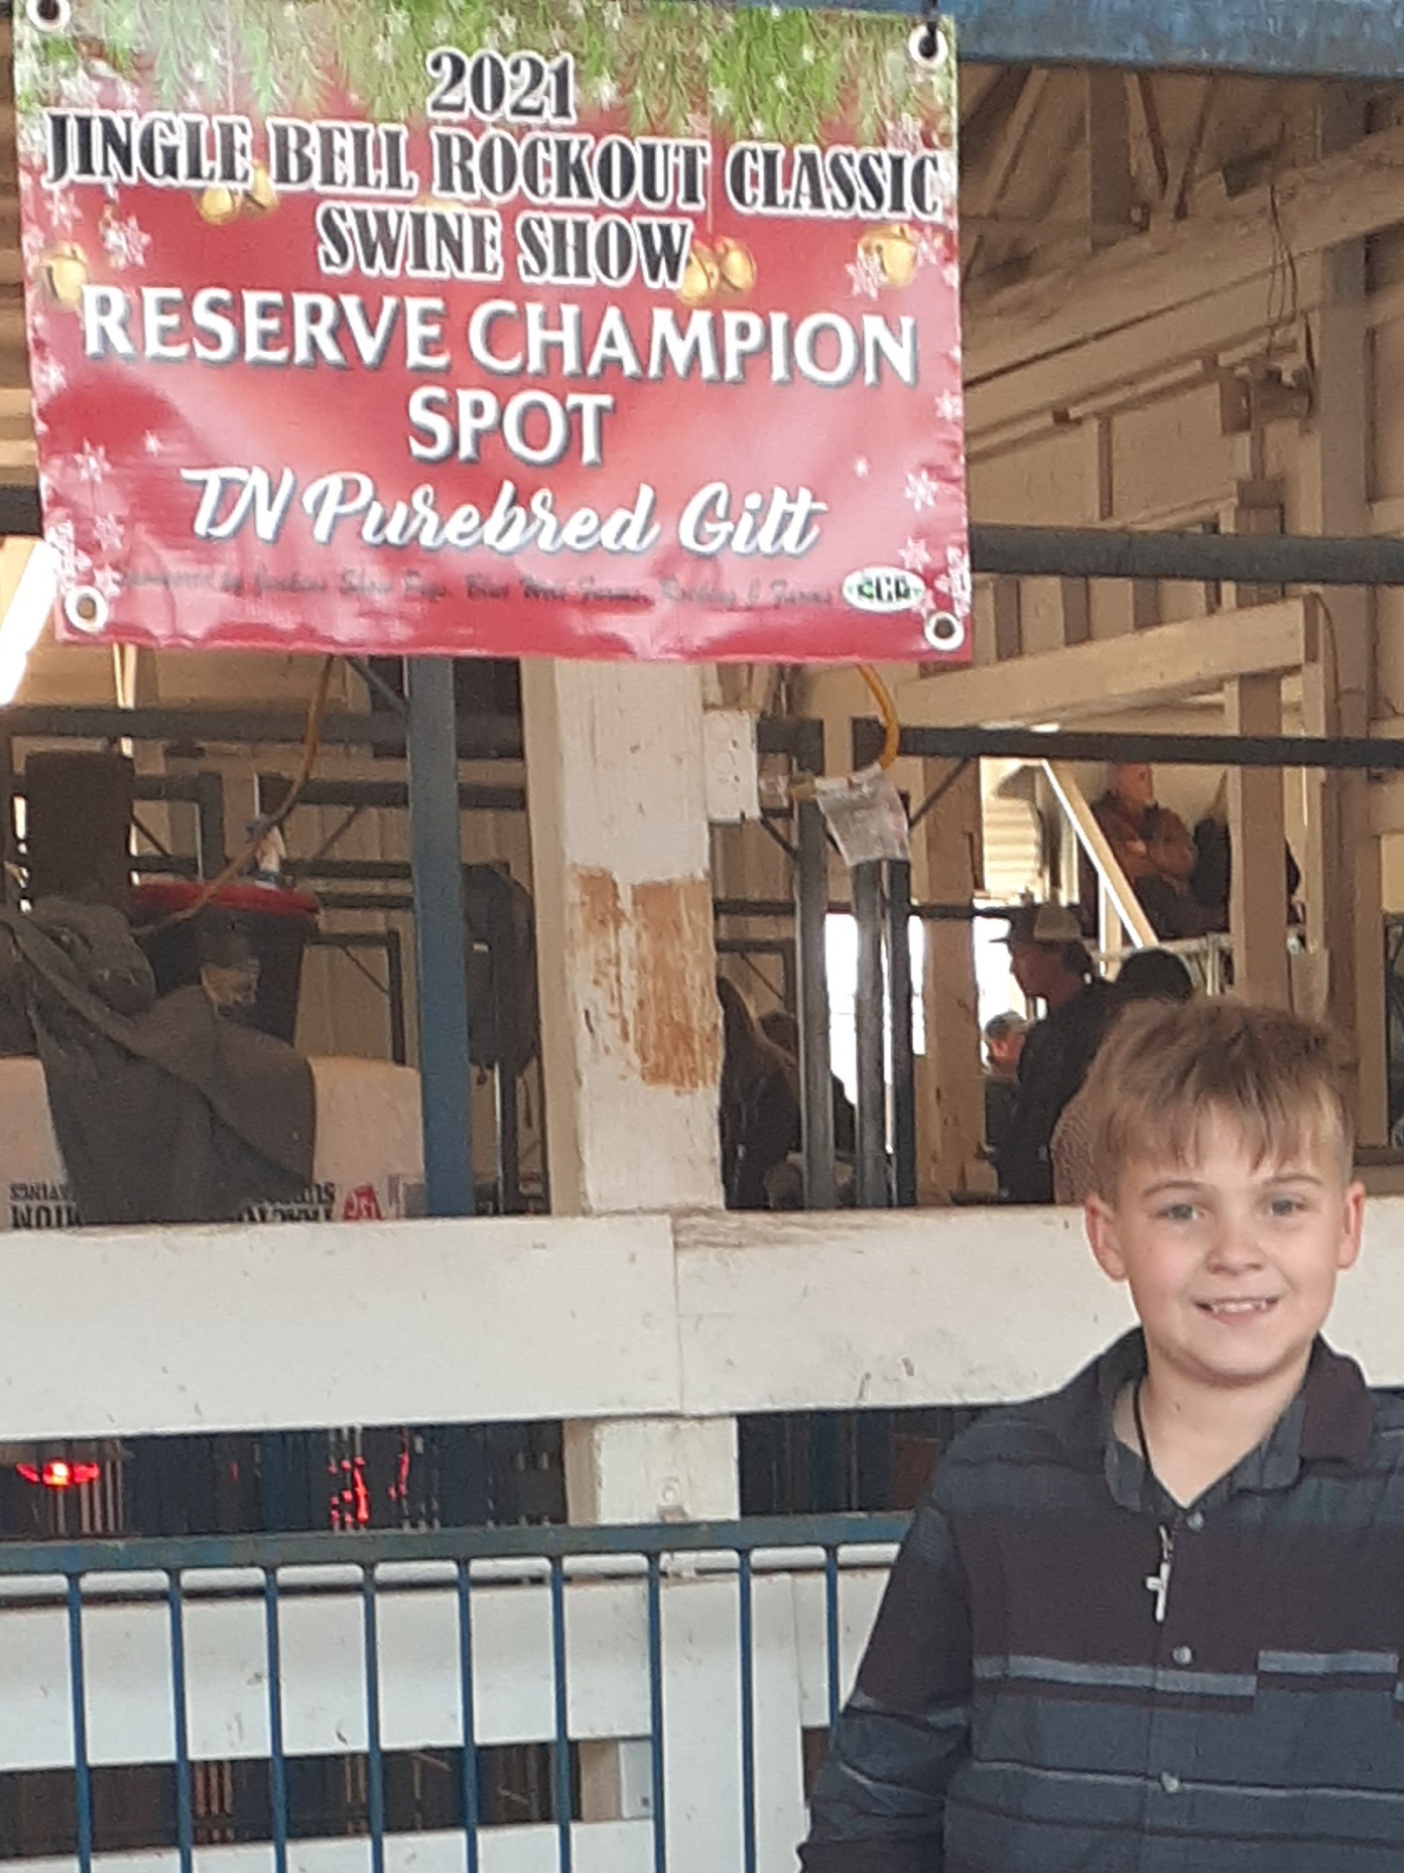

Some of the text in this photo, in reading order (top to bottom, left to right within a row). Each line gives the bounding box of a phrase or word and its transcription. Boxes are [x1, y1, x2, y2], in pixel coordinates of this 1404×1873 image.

[428, 50, 574, 120] 2021
[45, 110, 947, 219] JINGLE BELL ROCKOUT CLASSIC
[319, 205, 693, 288] SWINE SHOW
[82, 286, 918, 386] RESERVE CHAMPION
[408, 391, 616, 467] SPOT
[182, 467, 828, 558] TN Purebred Gilt
